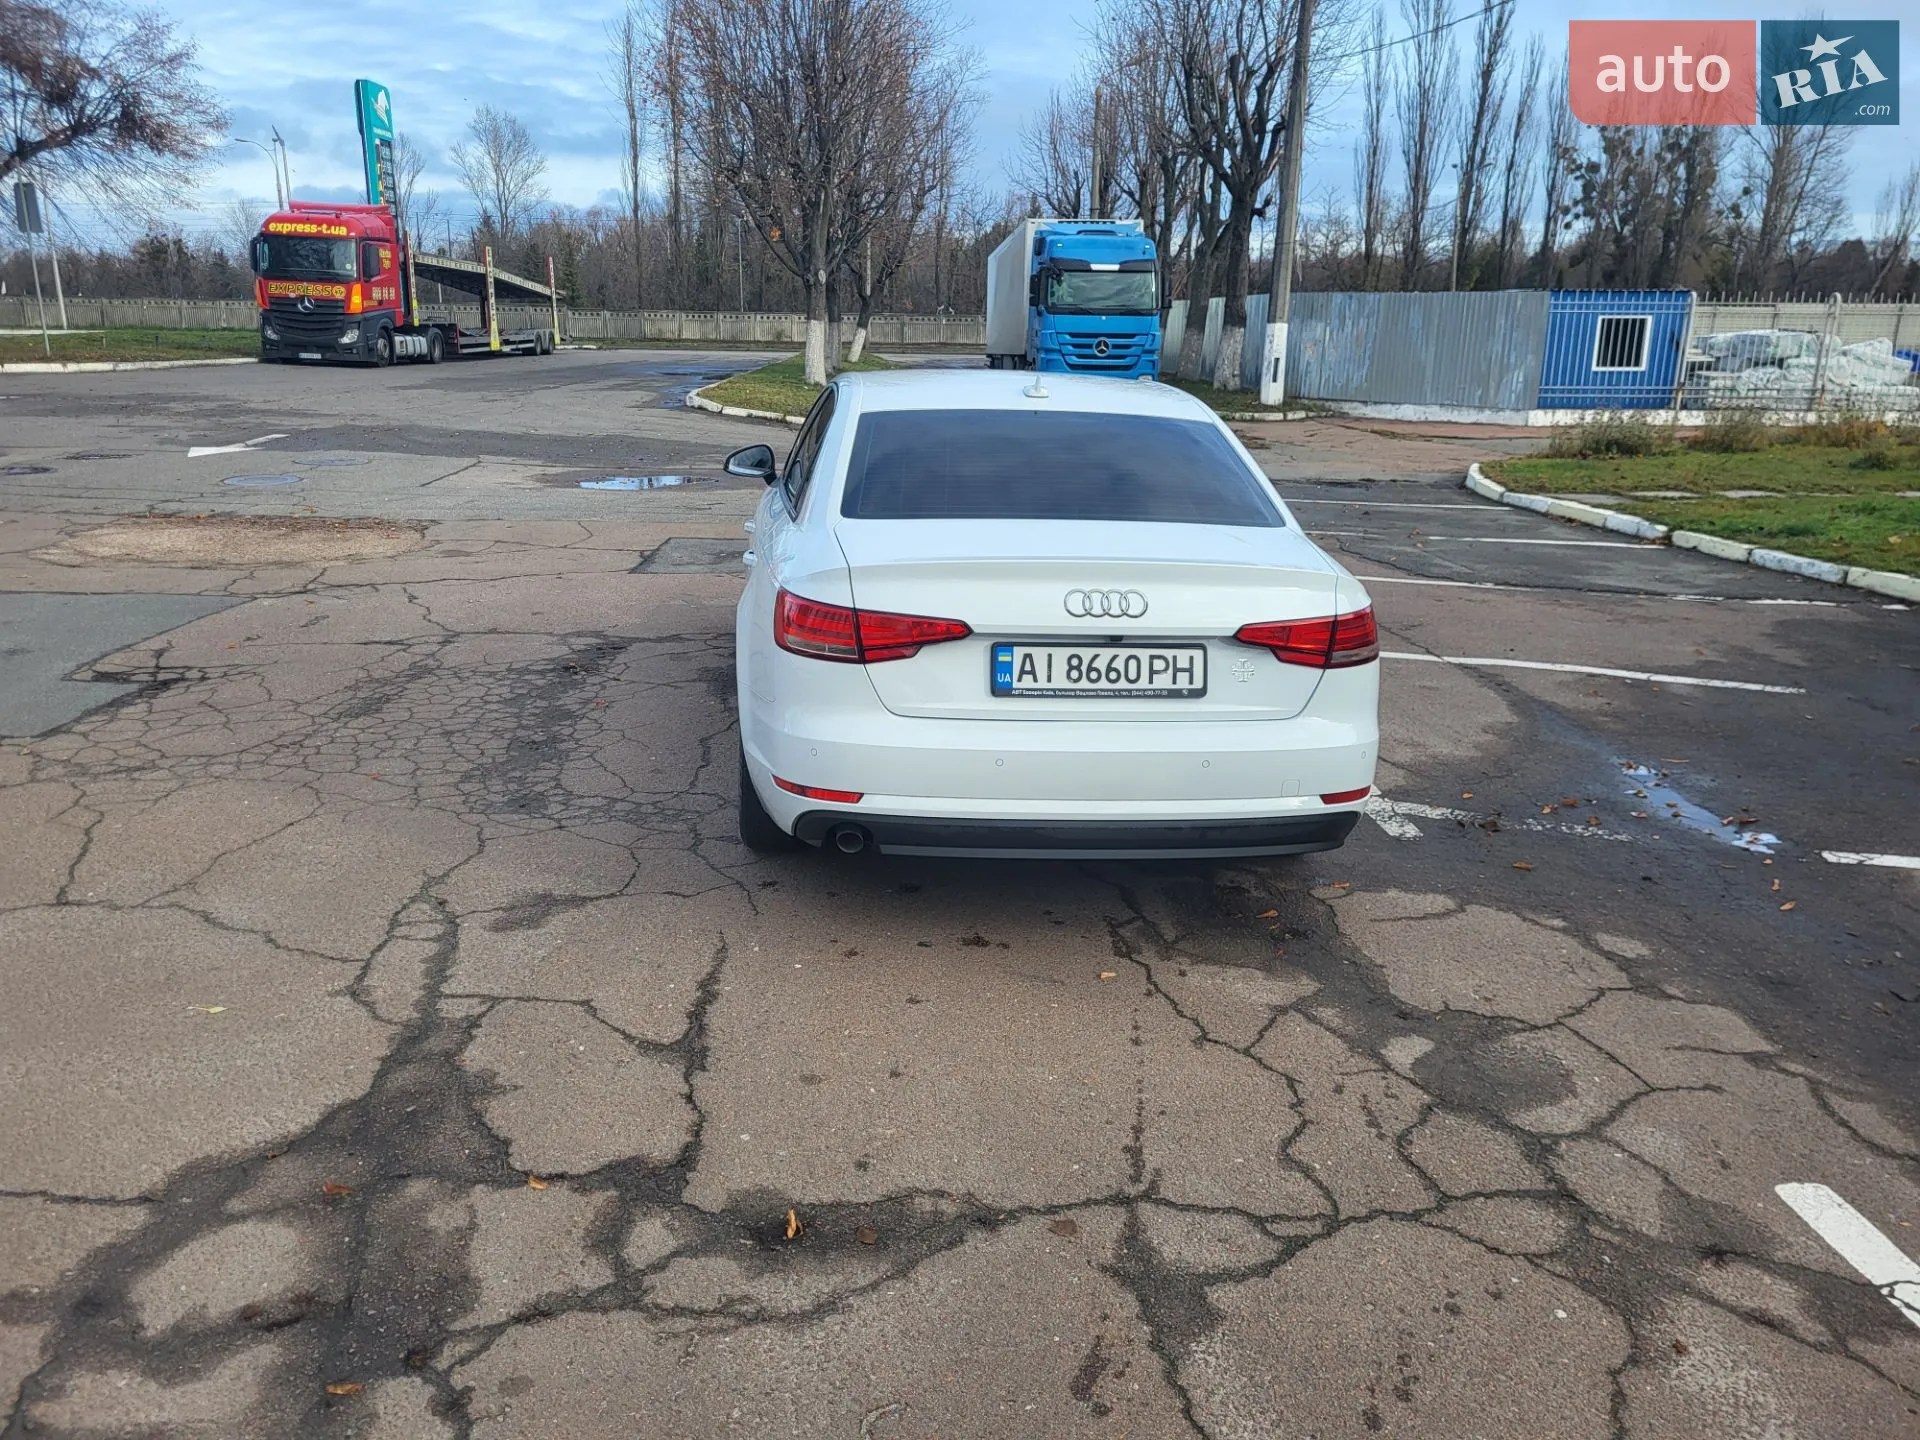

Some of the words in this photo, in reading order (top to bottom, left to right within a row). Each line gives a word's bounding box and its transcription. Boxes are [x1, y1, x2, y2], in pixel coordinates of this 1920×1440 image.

[268, 222, 348, 236] express-t.ua
[268, 282, 332, 297] EXPRESS
[1016, 653, 1053, 683] AI
[997, 672, 1011, 683] UA
